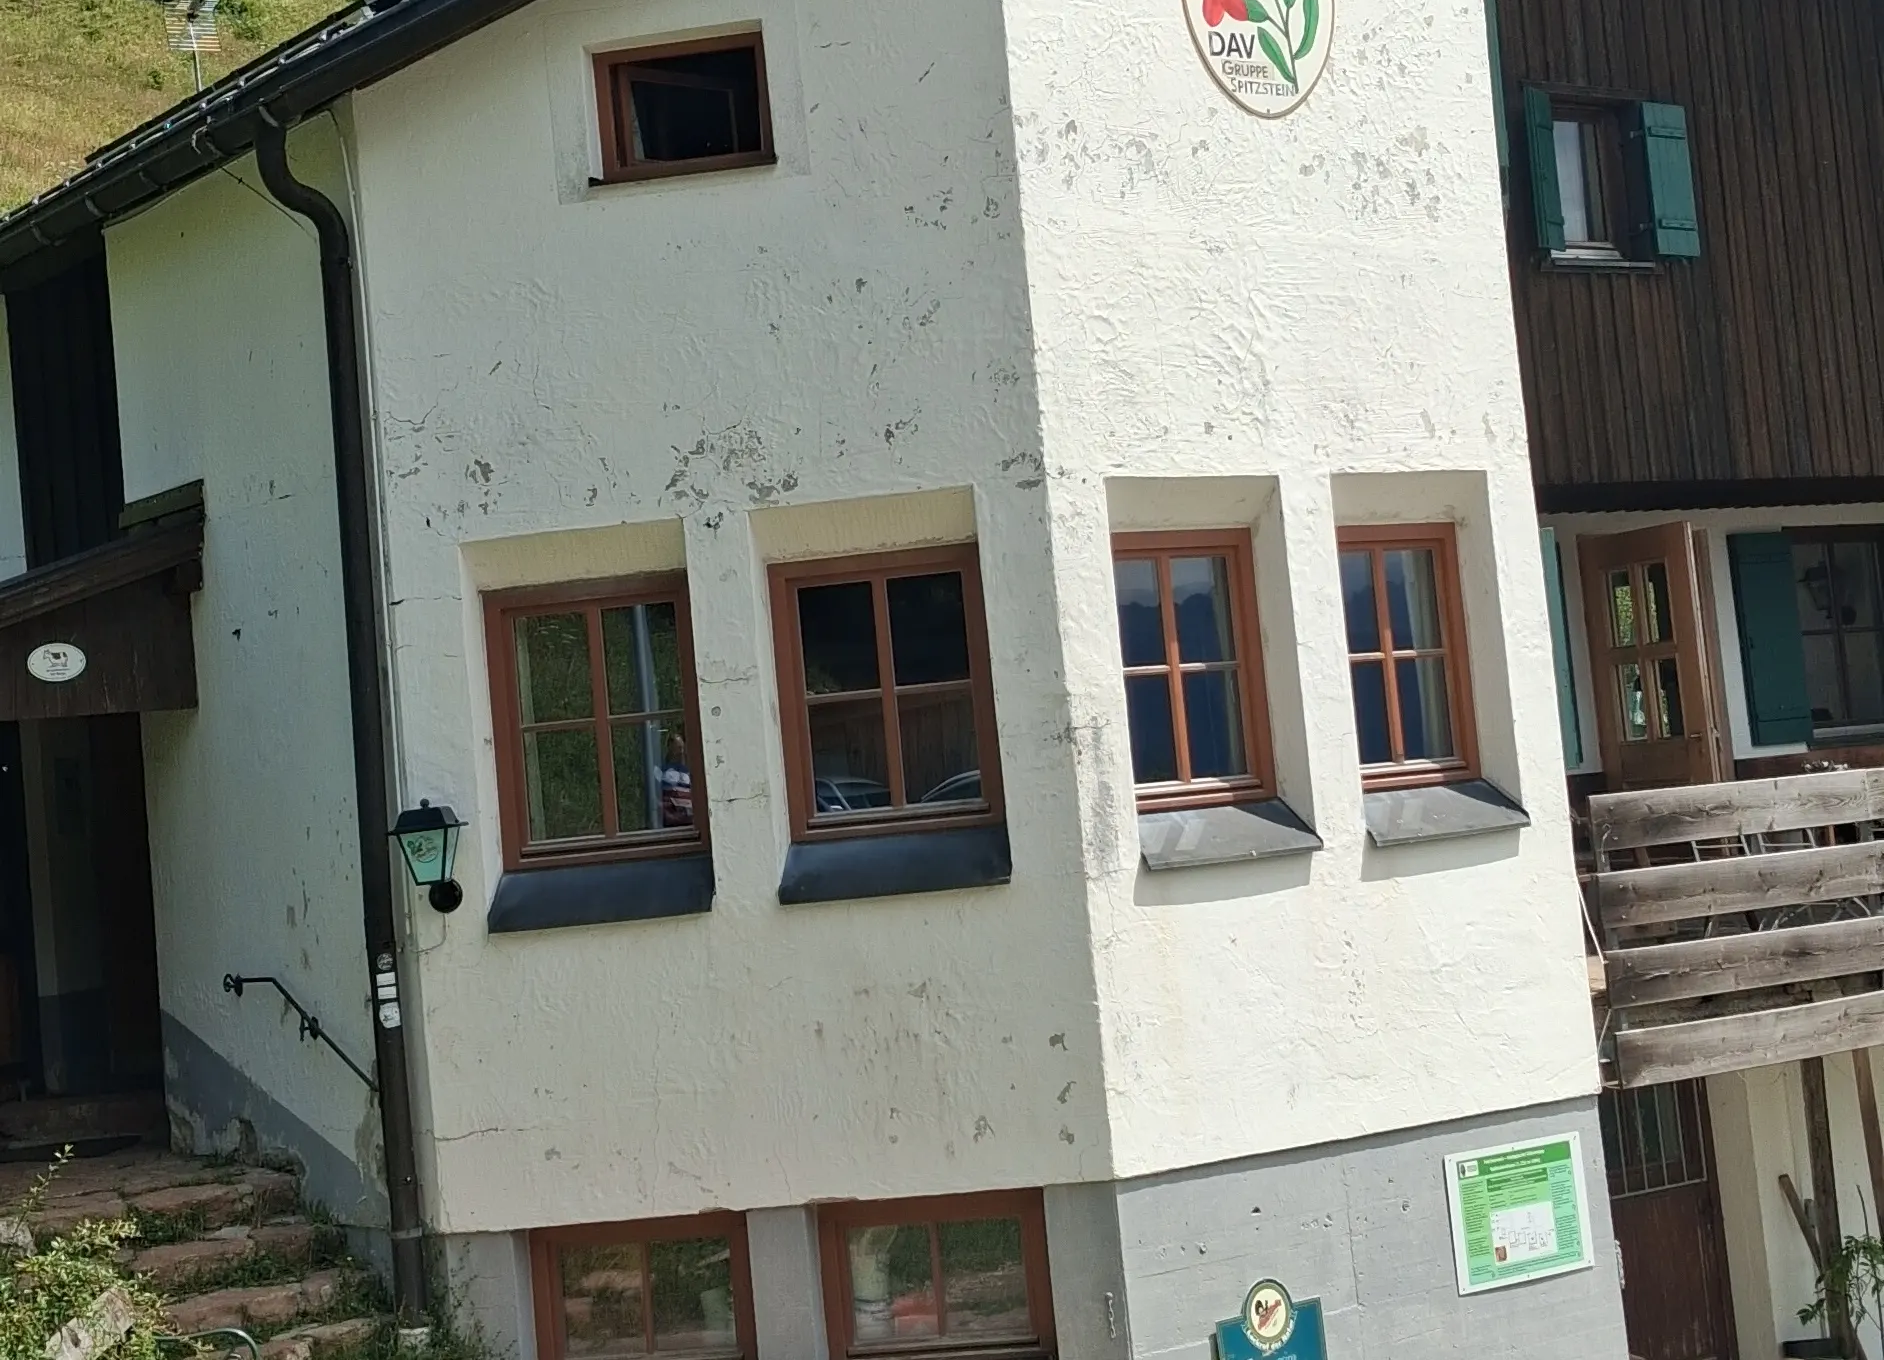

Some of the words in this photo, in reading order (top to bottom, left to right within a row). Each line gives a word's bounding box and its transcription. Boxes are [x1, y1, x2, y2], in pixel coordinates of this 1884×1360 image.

[1208, 30, 1255, 59] DAV
[1222, 60, 1268, 78] GRUPPE
[1230, 77, 1295, 96] SPITZSTEIN
